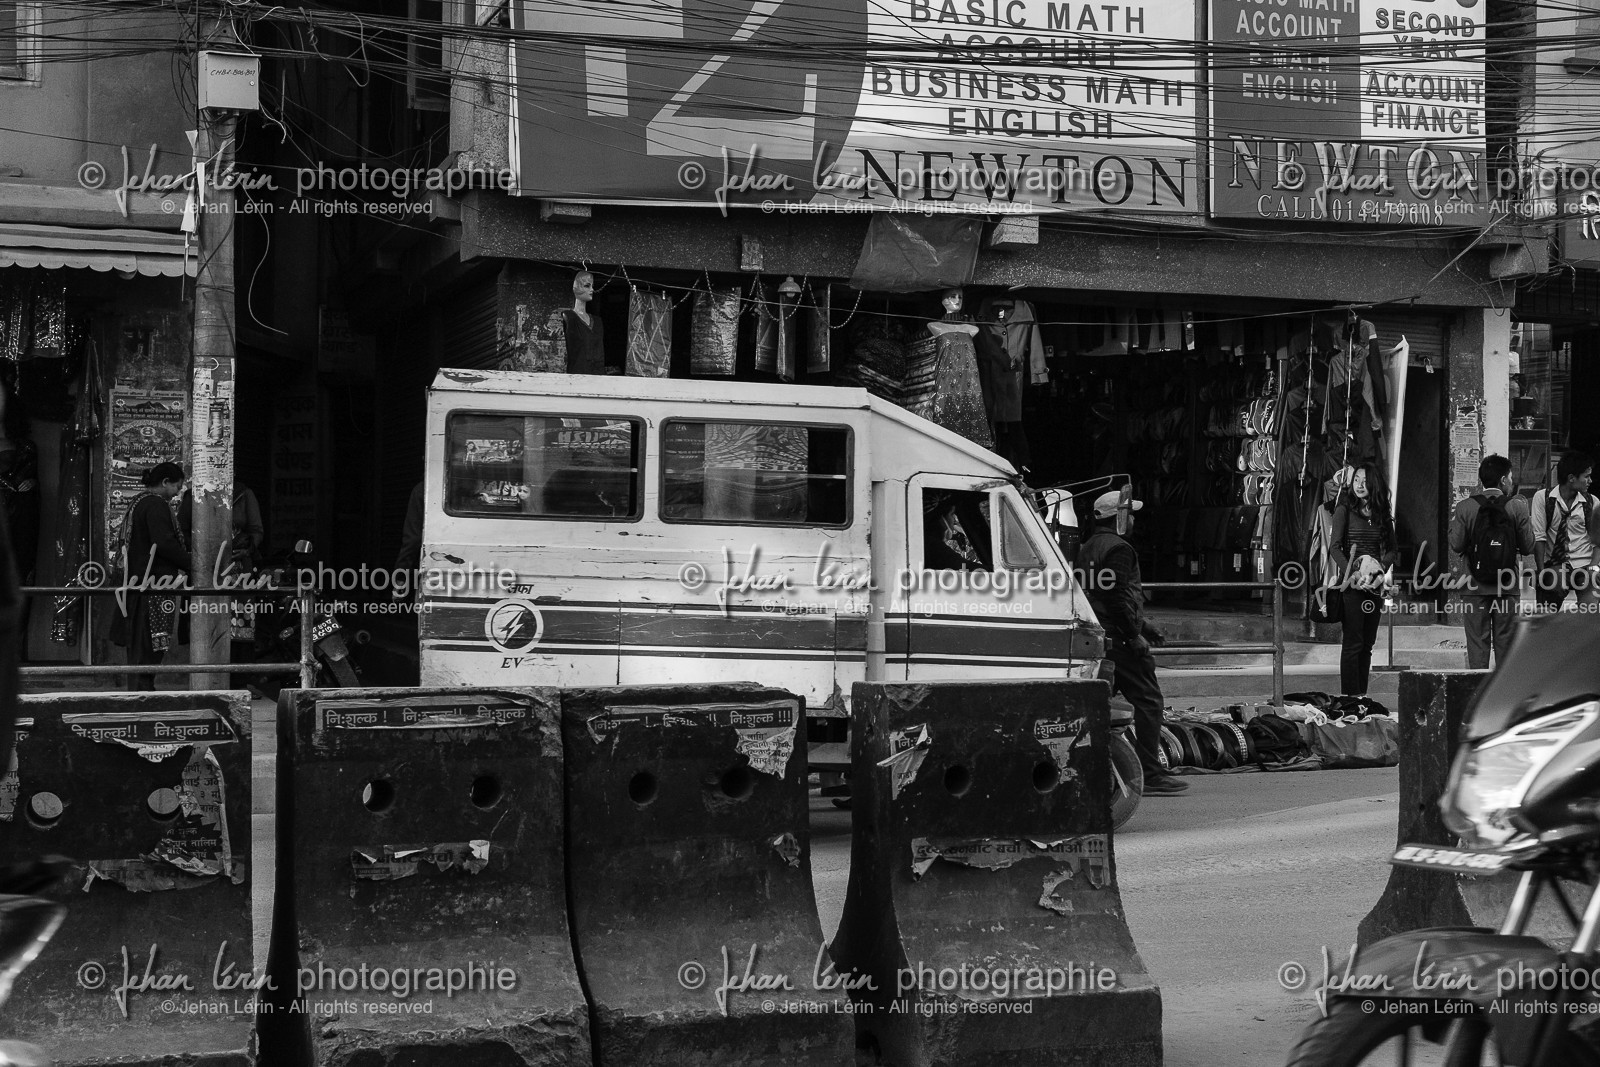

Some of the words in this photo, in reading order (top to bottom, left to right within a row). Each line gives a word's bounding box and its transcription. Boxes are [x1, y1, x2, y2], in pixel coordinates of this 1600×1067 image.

[910, 0, 1027, 27] BASIC
[1048, 2, 1144, 33] MATH
[1236, 9, 1342, 42] ACCOUNT
[1375, 7, 1475, 37] SECOND
[936, 33, 1120, 67] ACCOUNT
[1393, 35, 1458, 58] YEAR
[872, 67, 1066, 101] BUSINESS
[1086, 77, 1182, 106] MATH
[1242, 73, 1337, 104] ENGLISH
[1366, 70, 1484, 104] ACCOUNT
[948, 108, 1113, 139] ENGLISH
[1372, 102, 1480, 135] FINANCE
[855, 149, 1190, 207] NEWTON
[1228, 134, 1482, 200] NEWTON
[1257, 194, 1322, 220] CALL
[501, 657, 524, 669] EV
